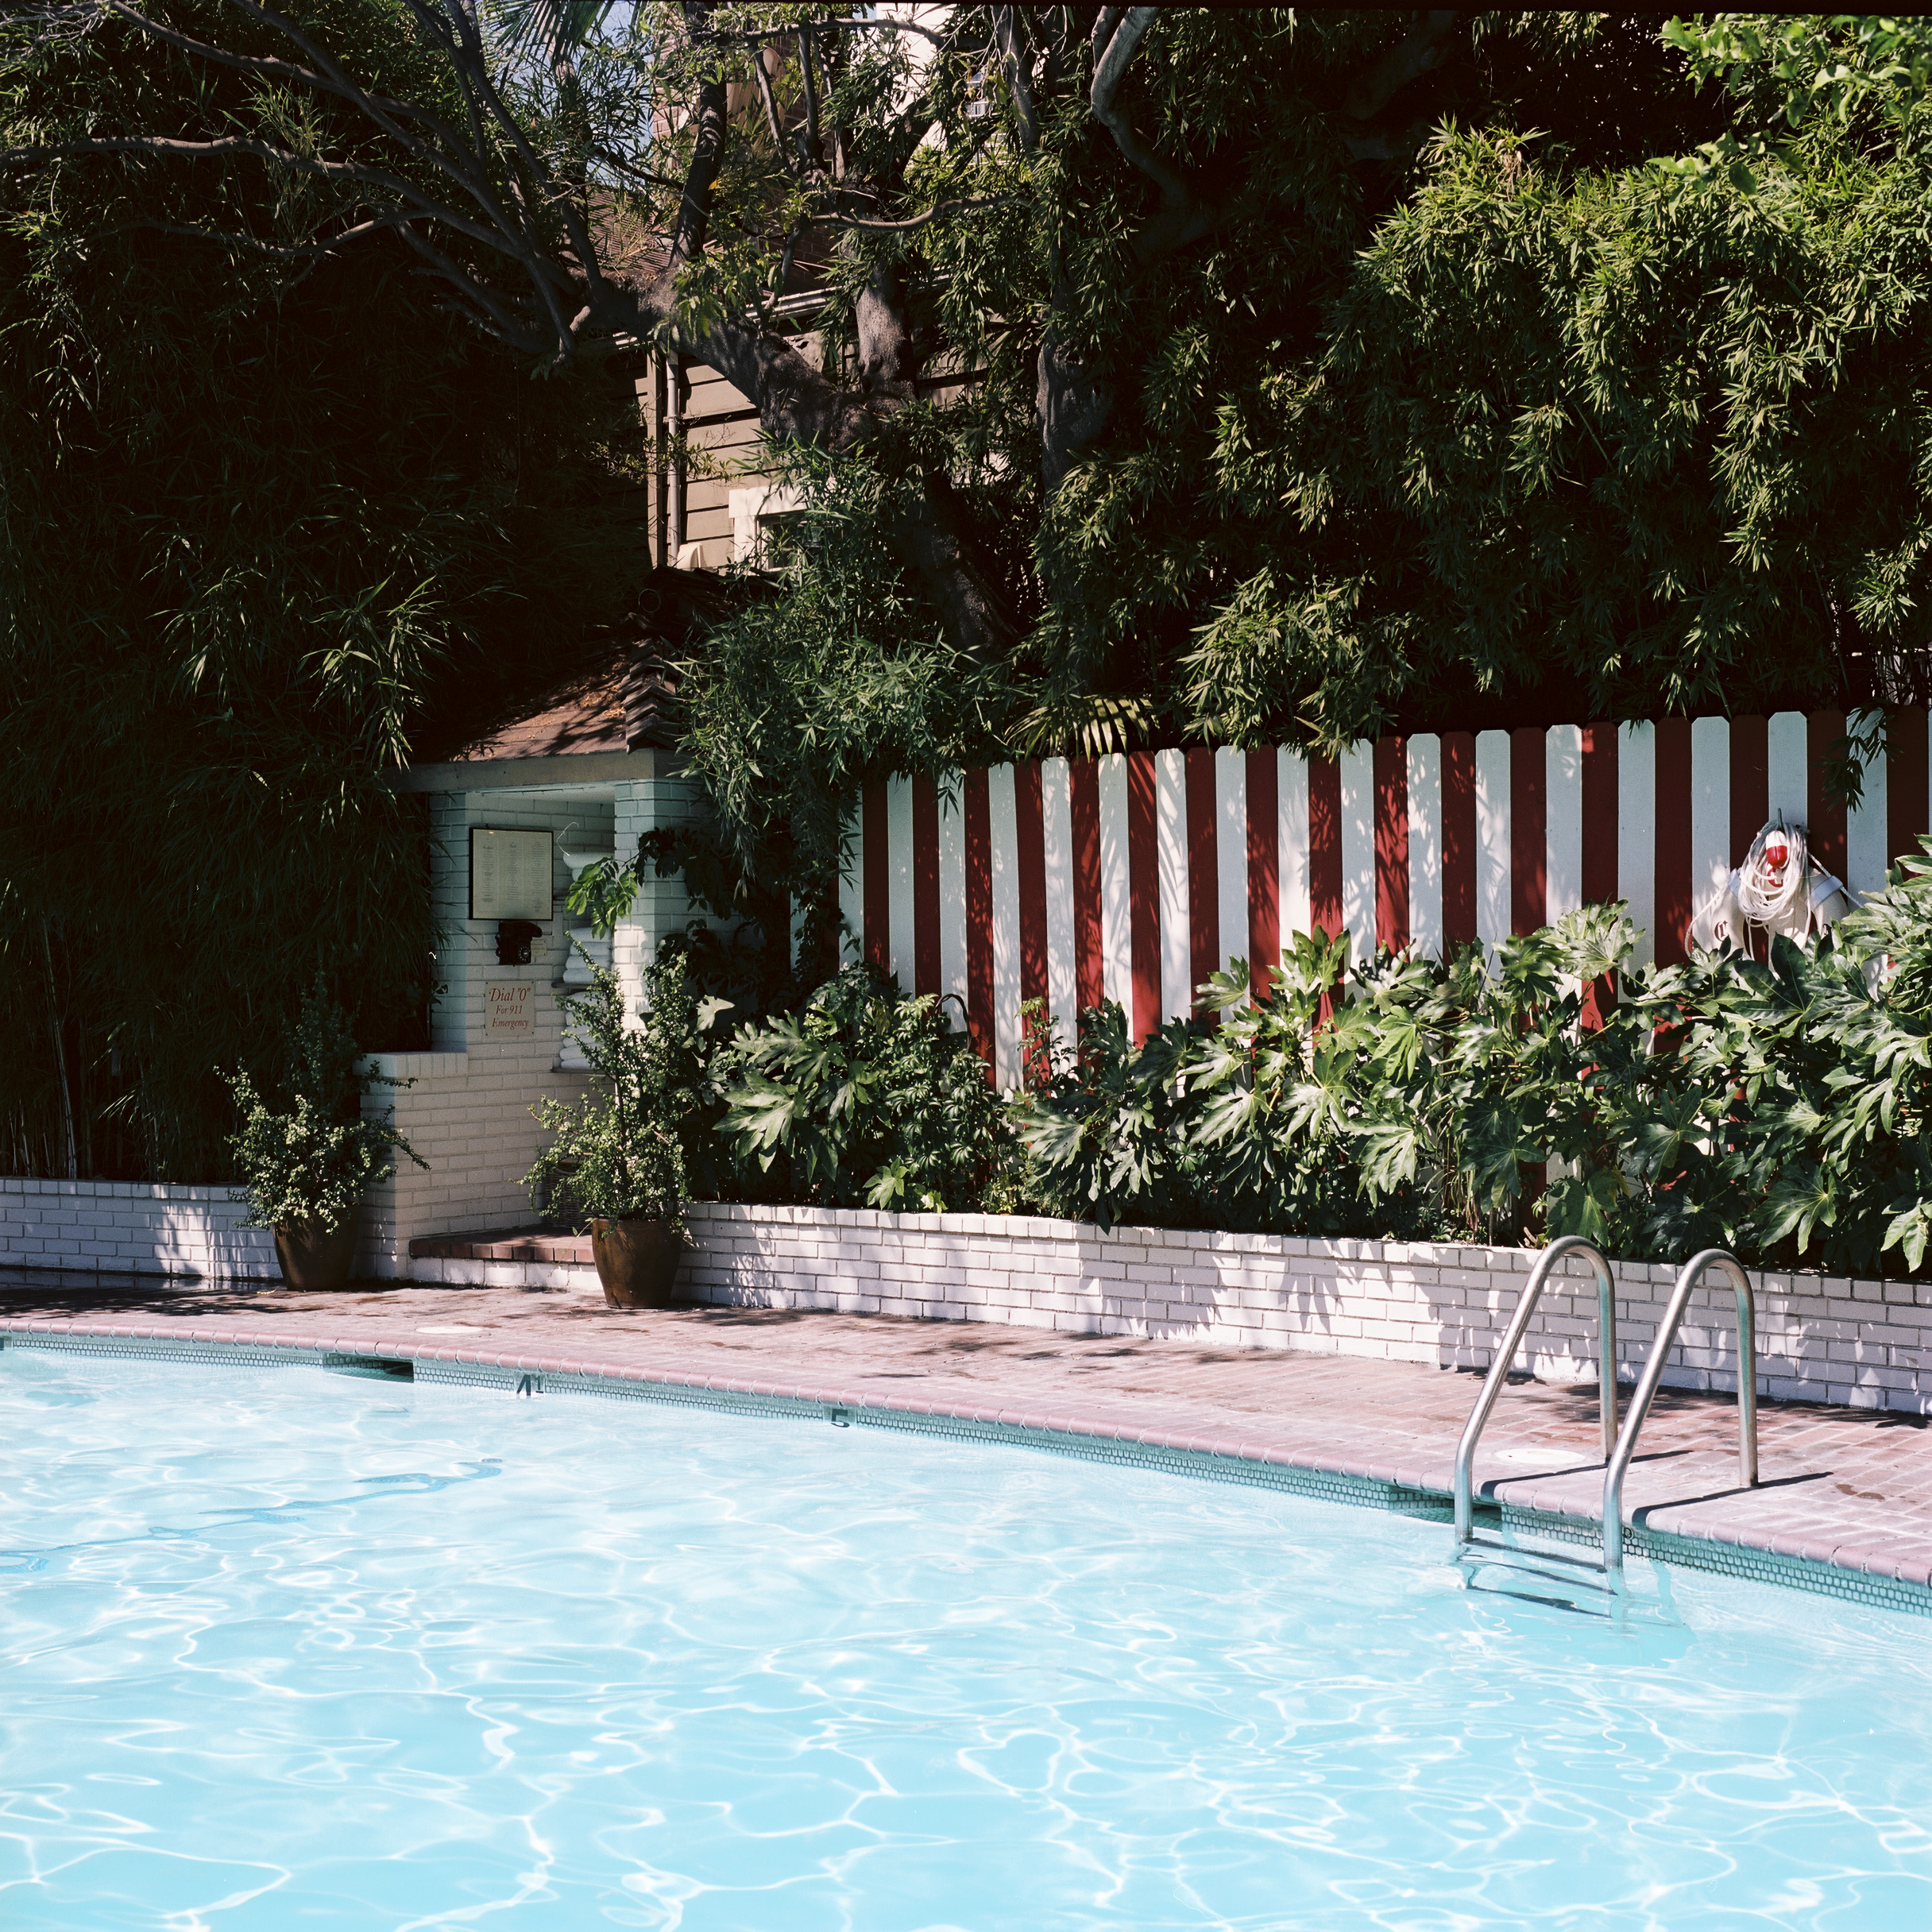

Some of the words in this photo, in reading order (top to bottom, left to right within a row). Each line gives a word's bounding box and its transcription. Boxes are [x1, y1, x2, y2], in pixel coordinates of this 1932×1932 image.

[489, 987, 516, 1002] Dial
[496, 1004, 508, 1014] For
[509, 1005, 523, 1014] 911
[492, 1018, 529, 1030] Emergency
